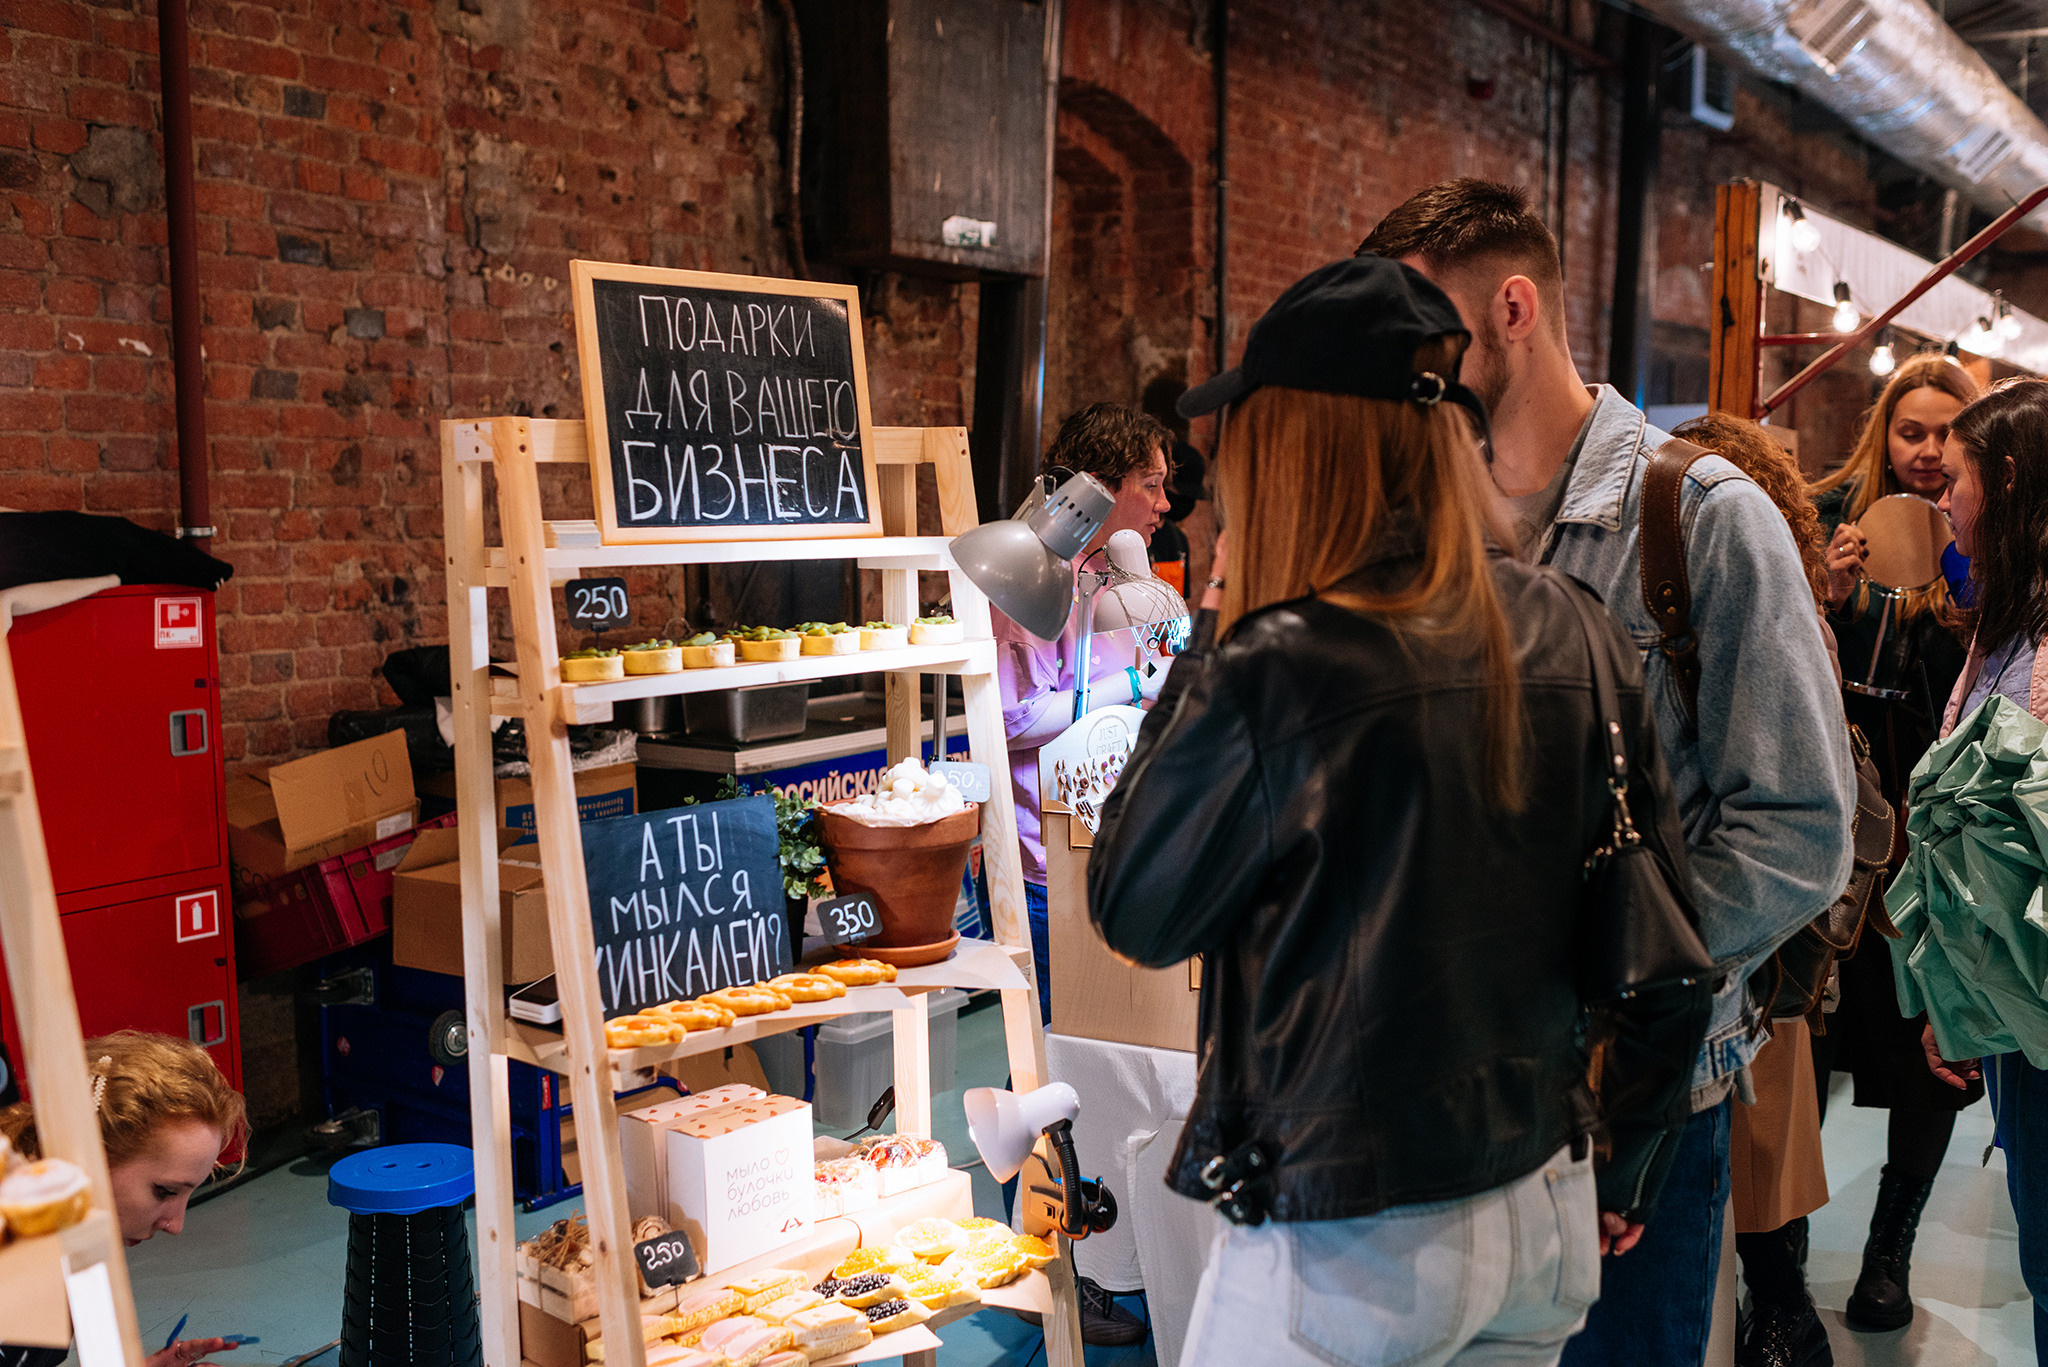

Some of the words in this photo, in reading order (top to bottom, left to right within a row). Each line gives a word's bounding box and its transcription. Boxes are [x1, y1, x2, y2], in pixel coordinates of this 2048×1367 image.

[639, 295, 815, 357] ПОДАРКИ
[625, 367, 713, 433] ДЛЯ
[726, 370, 858, 440] ВАШЕГО
[622, 440, 865, 521] БИЗНЕСА
[574, 585, 628, 619] 250
[640, 821, 664, 882] А
[666, 811, 723, 874] ТЫ
[610, 870, 752, 935] МЫЛСЯ
[830, 900, 874, 936] 350
[727, 1157, 770, 1183] мыло
[727, 1168, 793, 1203] булочки
[728, 1190, 790, 1221] любовь
[643, 1241, 684, 1270] 250
